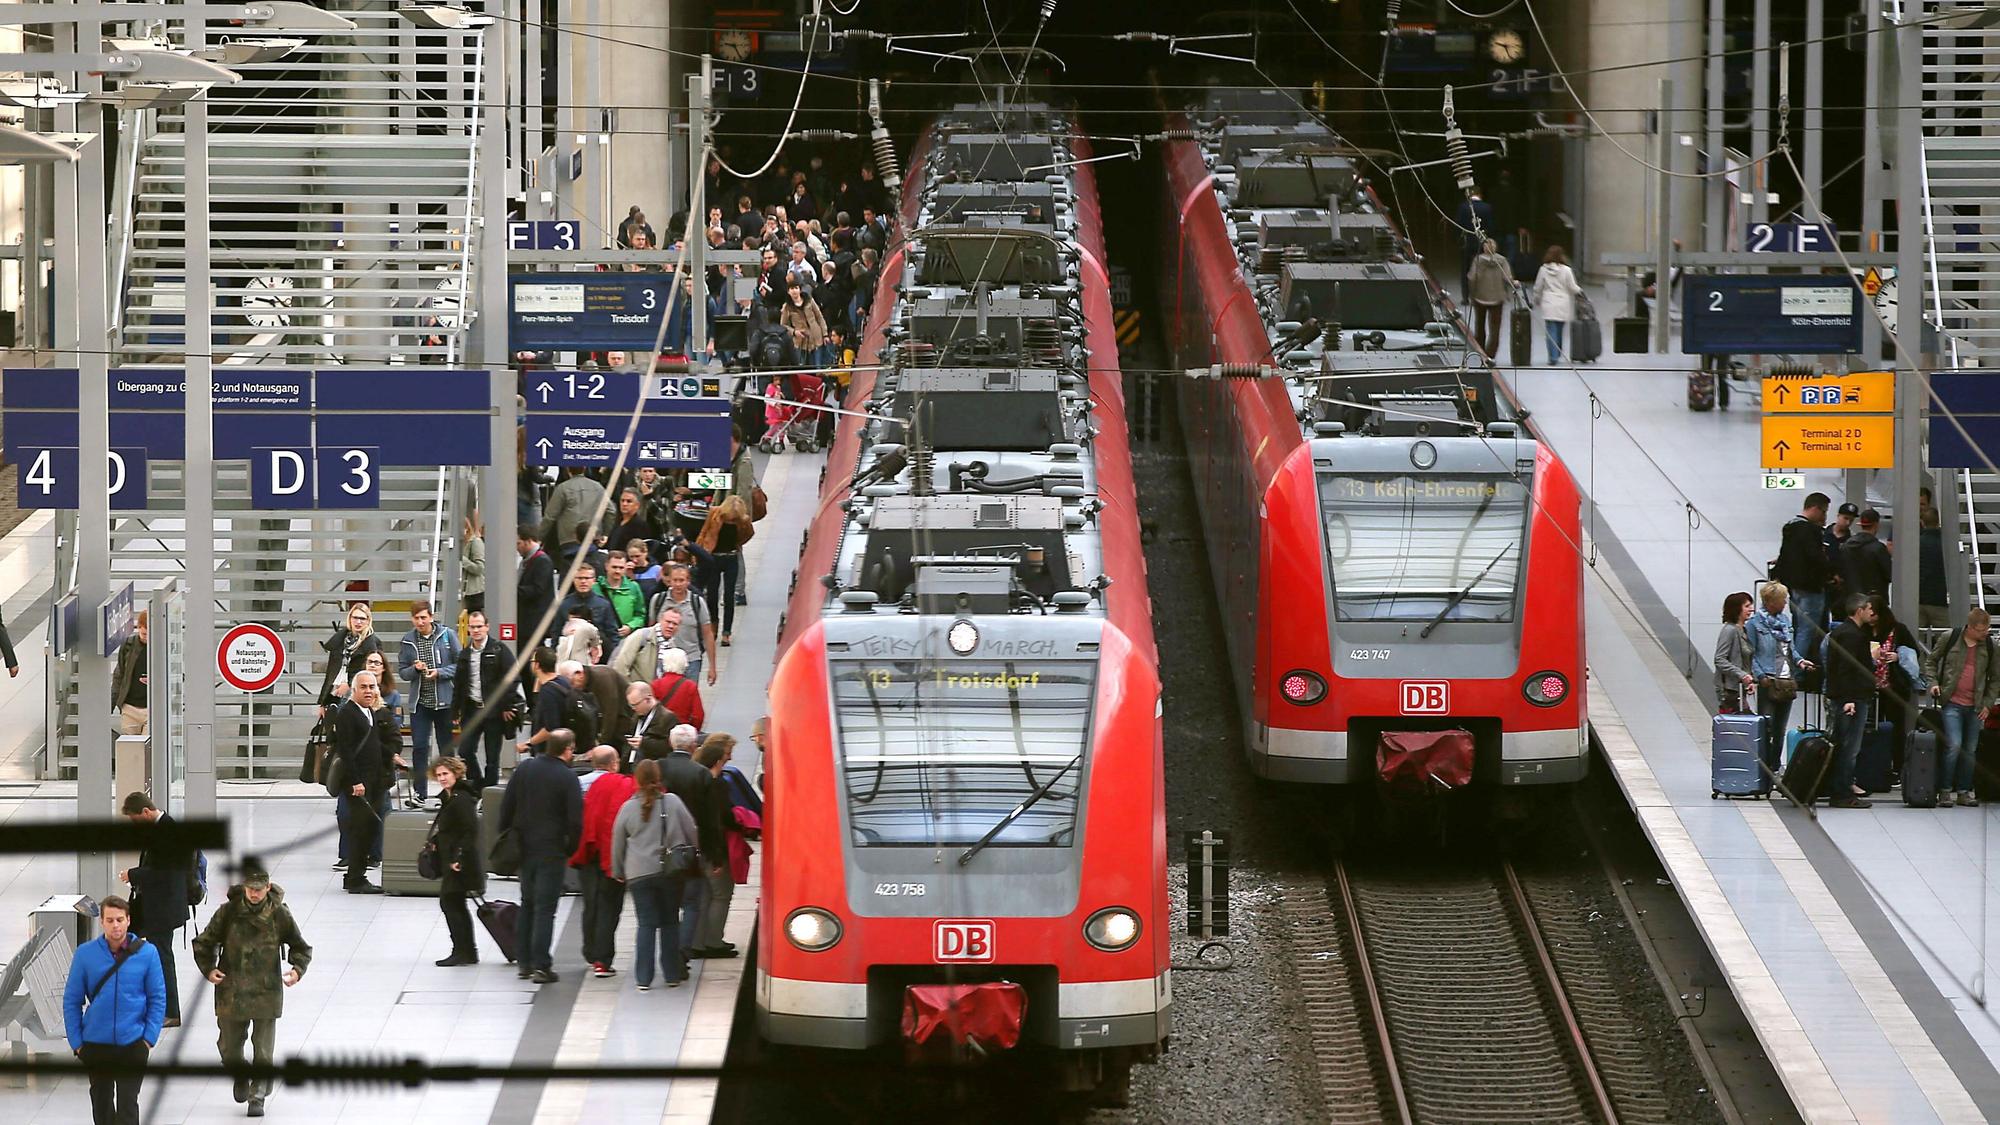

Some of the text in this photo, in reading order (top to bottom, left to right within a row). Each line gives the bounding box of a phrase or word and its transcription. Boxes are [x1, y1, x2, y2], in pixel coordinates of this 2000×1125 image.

[742, 68, 757, 91] 3
[1492, 68, 1508, 93] 2
[553, 222, 575, 250] 3
[1752, 224, 1775, 252] 2
[641, 288, 657, 310] 3
[1709, 291, 1724, 311] 2
[610, 313, 650, 323] Troisdorf
[117, 380, 164, 394] Übergang
[166, 384, 178, 392] zu
[222, 383, 240, 393] und
[243, 383, 299, 395] Notausgang
[563, 374, 606, 399] 1-2
[683, 383, 698, 391] Bus
[562, 426, 606, 438] Ausgang
[1801, 429, 1862, 438] Terminal 2 D
[1801, 442, 1862, 451] Terminal 1 C
[25, 450, 56, 495] 4
[271, 449, 372, 495] D 3
[235, 649, 267, 658] Notausgang
[242, 658, 271, 666] Bahnsteig-
[1350, 649, 1391, 660] 423 747
[933, 668, 1040, 689] Troisdorf
[1405, 685, 1444, 709] DB
[875, 883, 926, 896] 423 758
[941, 926, 988, 957] DB
